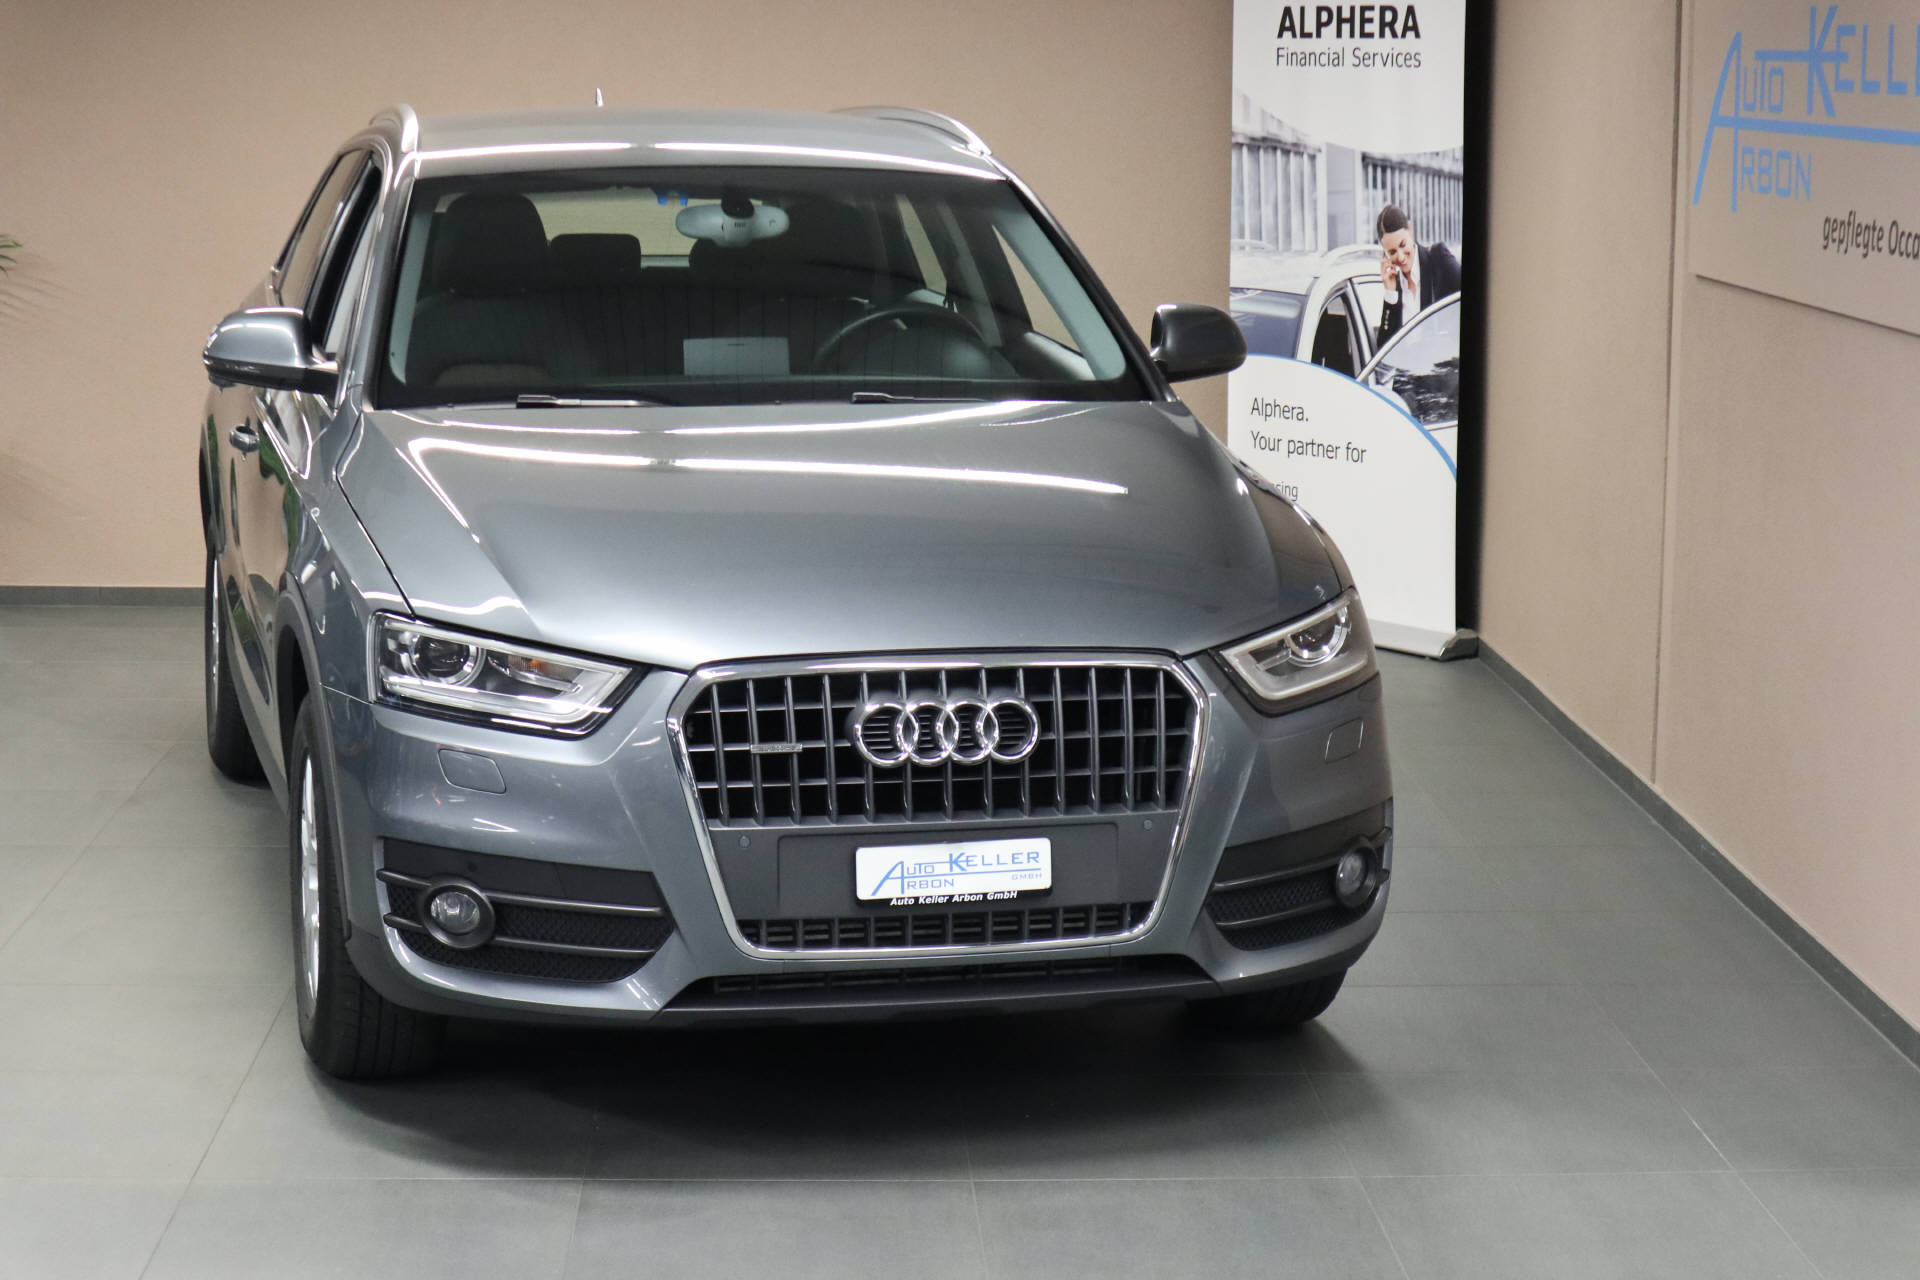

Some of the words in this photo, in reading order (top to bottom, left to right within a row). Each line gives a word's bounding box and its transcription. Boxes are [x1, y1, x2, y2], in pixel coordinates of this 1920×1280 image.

[1277, 5, 1421, 39] ALPHERA
[1276, 47, 1345, 67] Financial
[1352, 47, 1422, 68] Services
[1806, 5, 1920, 117] KELL
[1823, 209, 1884, 258] gepflegte
[1251, 397, 1309, 422] Alphera.
[1251, 431, 1282, 452] Your
[1287, 438, 1340, 459] partner
[1346, 442, 1367, 463] for
[949, 851, 1040, 872] KELLER
[890, 897, 914, 906] Auto
[918, 896, 949, 905] Keller
[952, 893, 983, 903] Arbon
[987, 890, 1018, 900] GmbH
